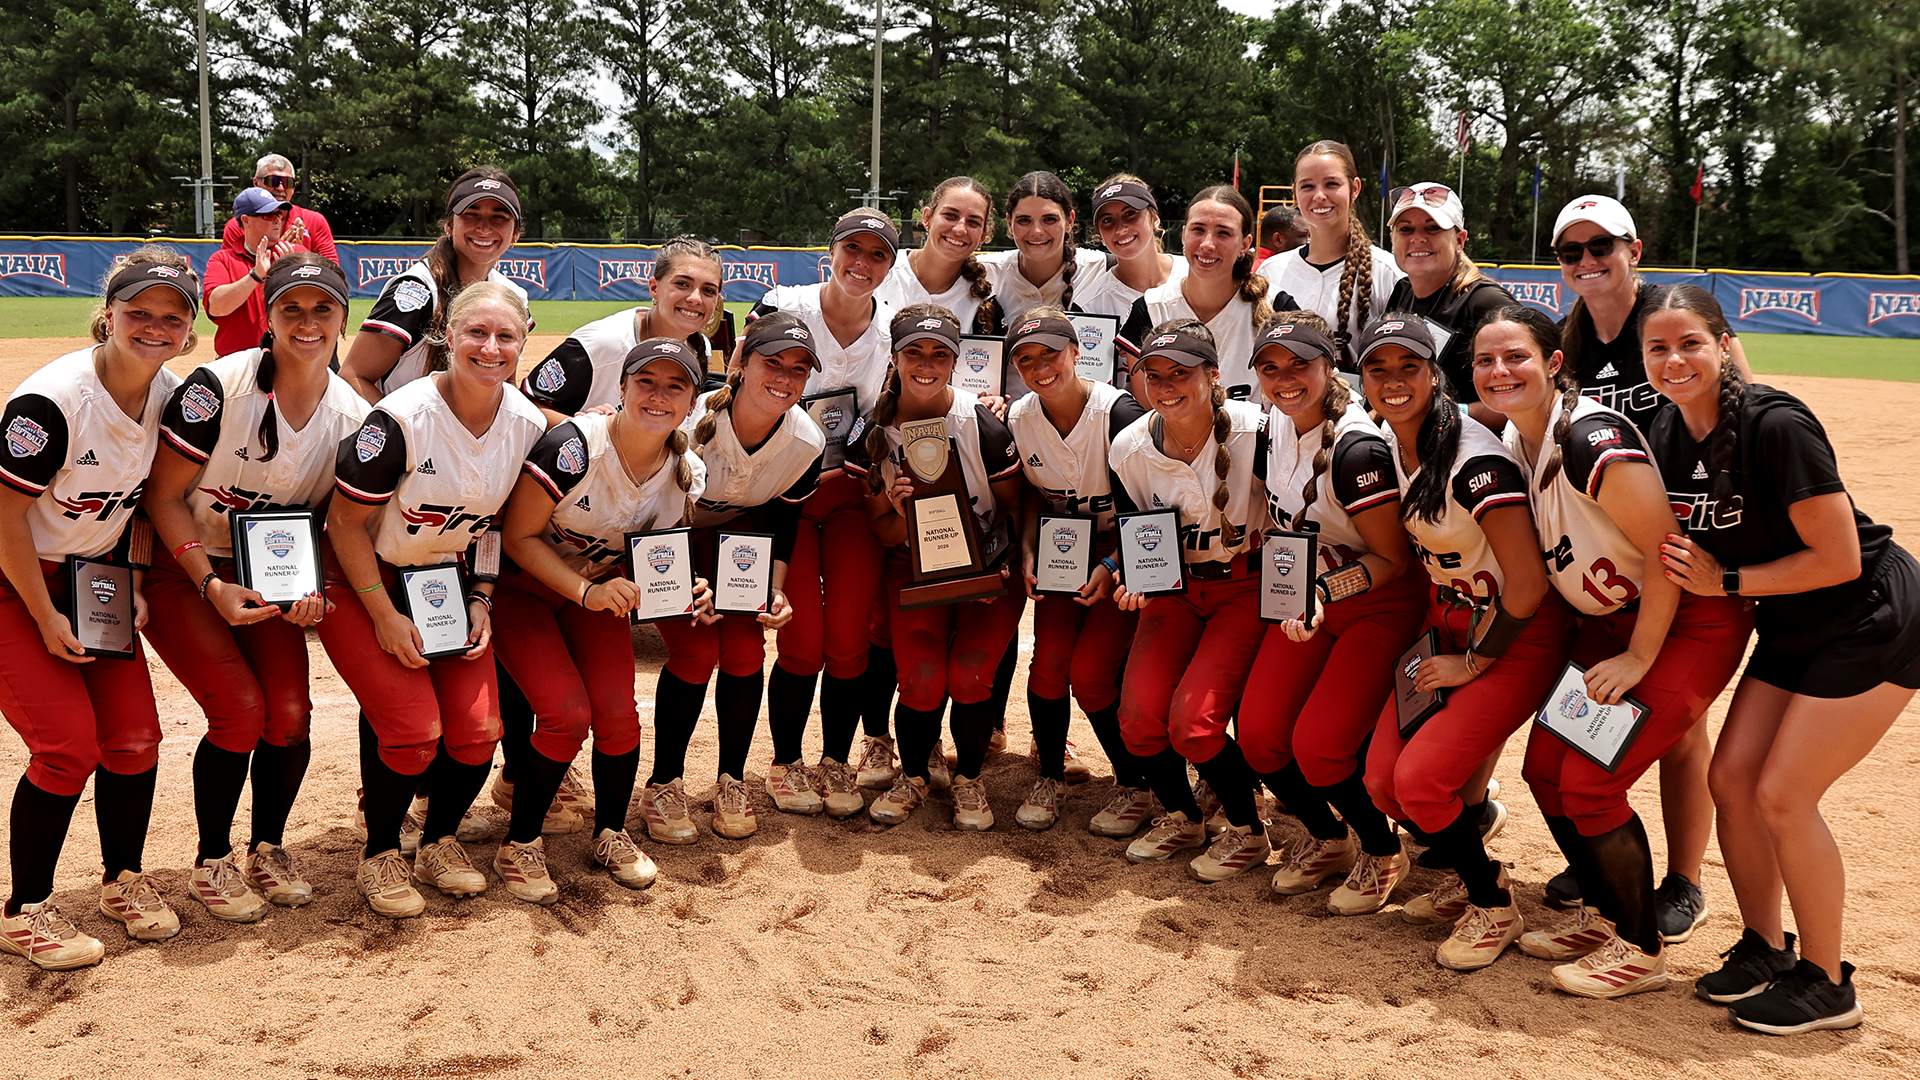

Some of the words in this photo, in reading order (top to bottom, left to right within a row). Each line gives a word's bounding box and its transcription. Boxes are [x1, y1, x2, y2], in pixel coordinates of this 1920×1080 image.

[359, 258, 421, 287] NAI
[496, 259, 546, 290] AIA
[599, 261, 656, 288] NAI
[723, 262, 777, 289] AIA
[1741, 288, 1819, 322] NAIA
[905, 424, 944, 443] NAIA
[923, 532, 959, 542] RUNNER-UP
[925, 527, 955, 536] NATIONAL
[1135, 562, 1169, 570] RUNNER-UP
[647, 585, 681, 594] RUNNER-UP
[1582, 556, 1640, 607] 13
[89, 617, 121, 625] RUNNER-UP
[91, 611, 118, 619] NATIONAL
[426, 619, 457, 628] RUNNER-UP
[428, 614, 453, 622] NATIONAL
[1586, 706, 1606, 734] NATIONAL
[1590, 706, 1612, 740] RUNNER-UP
